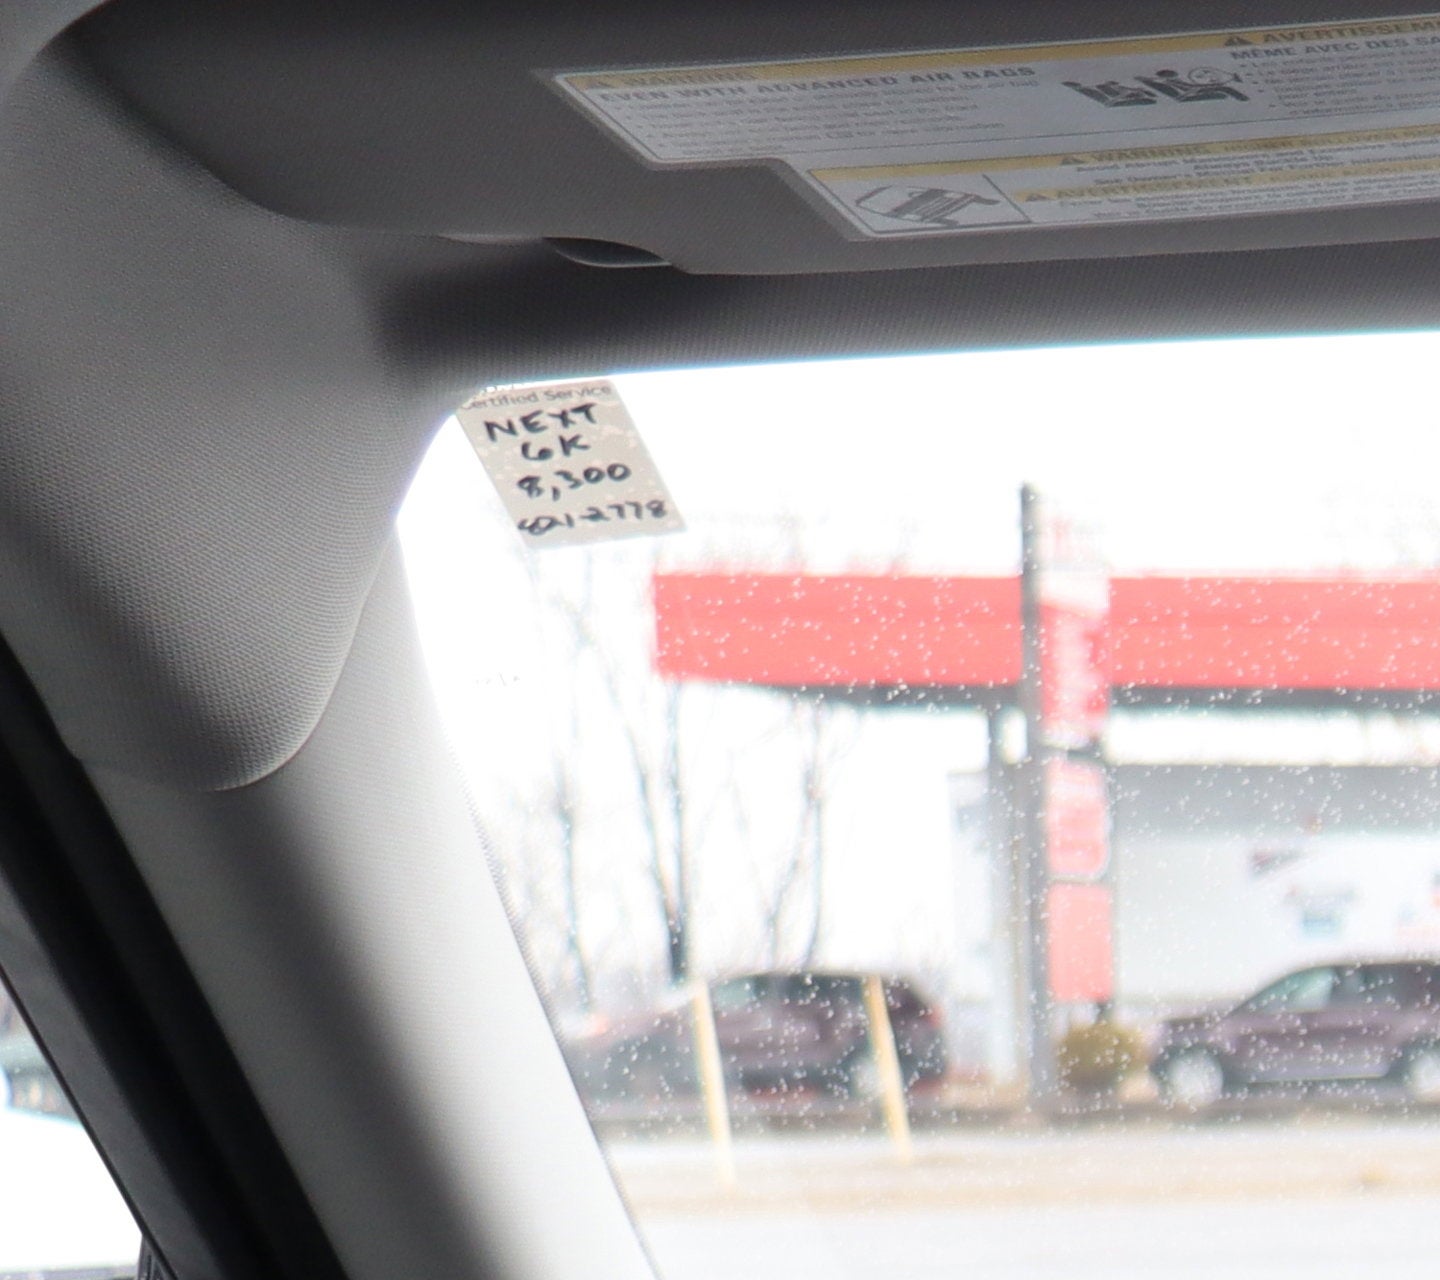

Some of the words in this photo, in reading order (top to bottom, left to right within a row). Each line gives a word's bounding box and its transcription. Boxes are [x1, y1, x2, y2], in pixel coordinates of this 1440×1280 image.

[910, 72, 953, 84] AIR
[544, 385, 613, 402] Service
[485, 403, 598, 442] NEXT
[517, 463, 631, 501] 8,300
